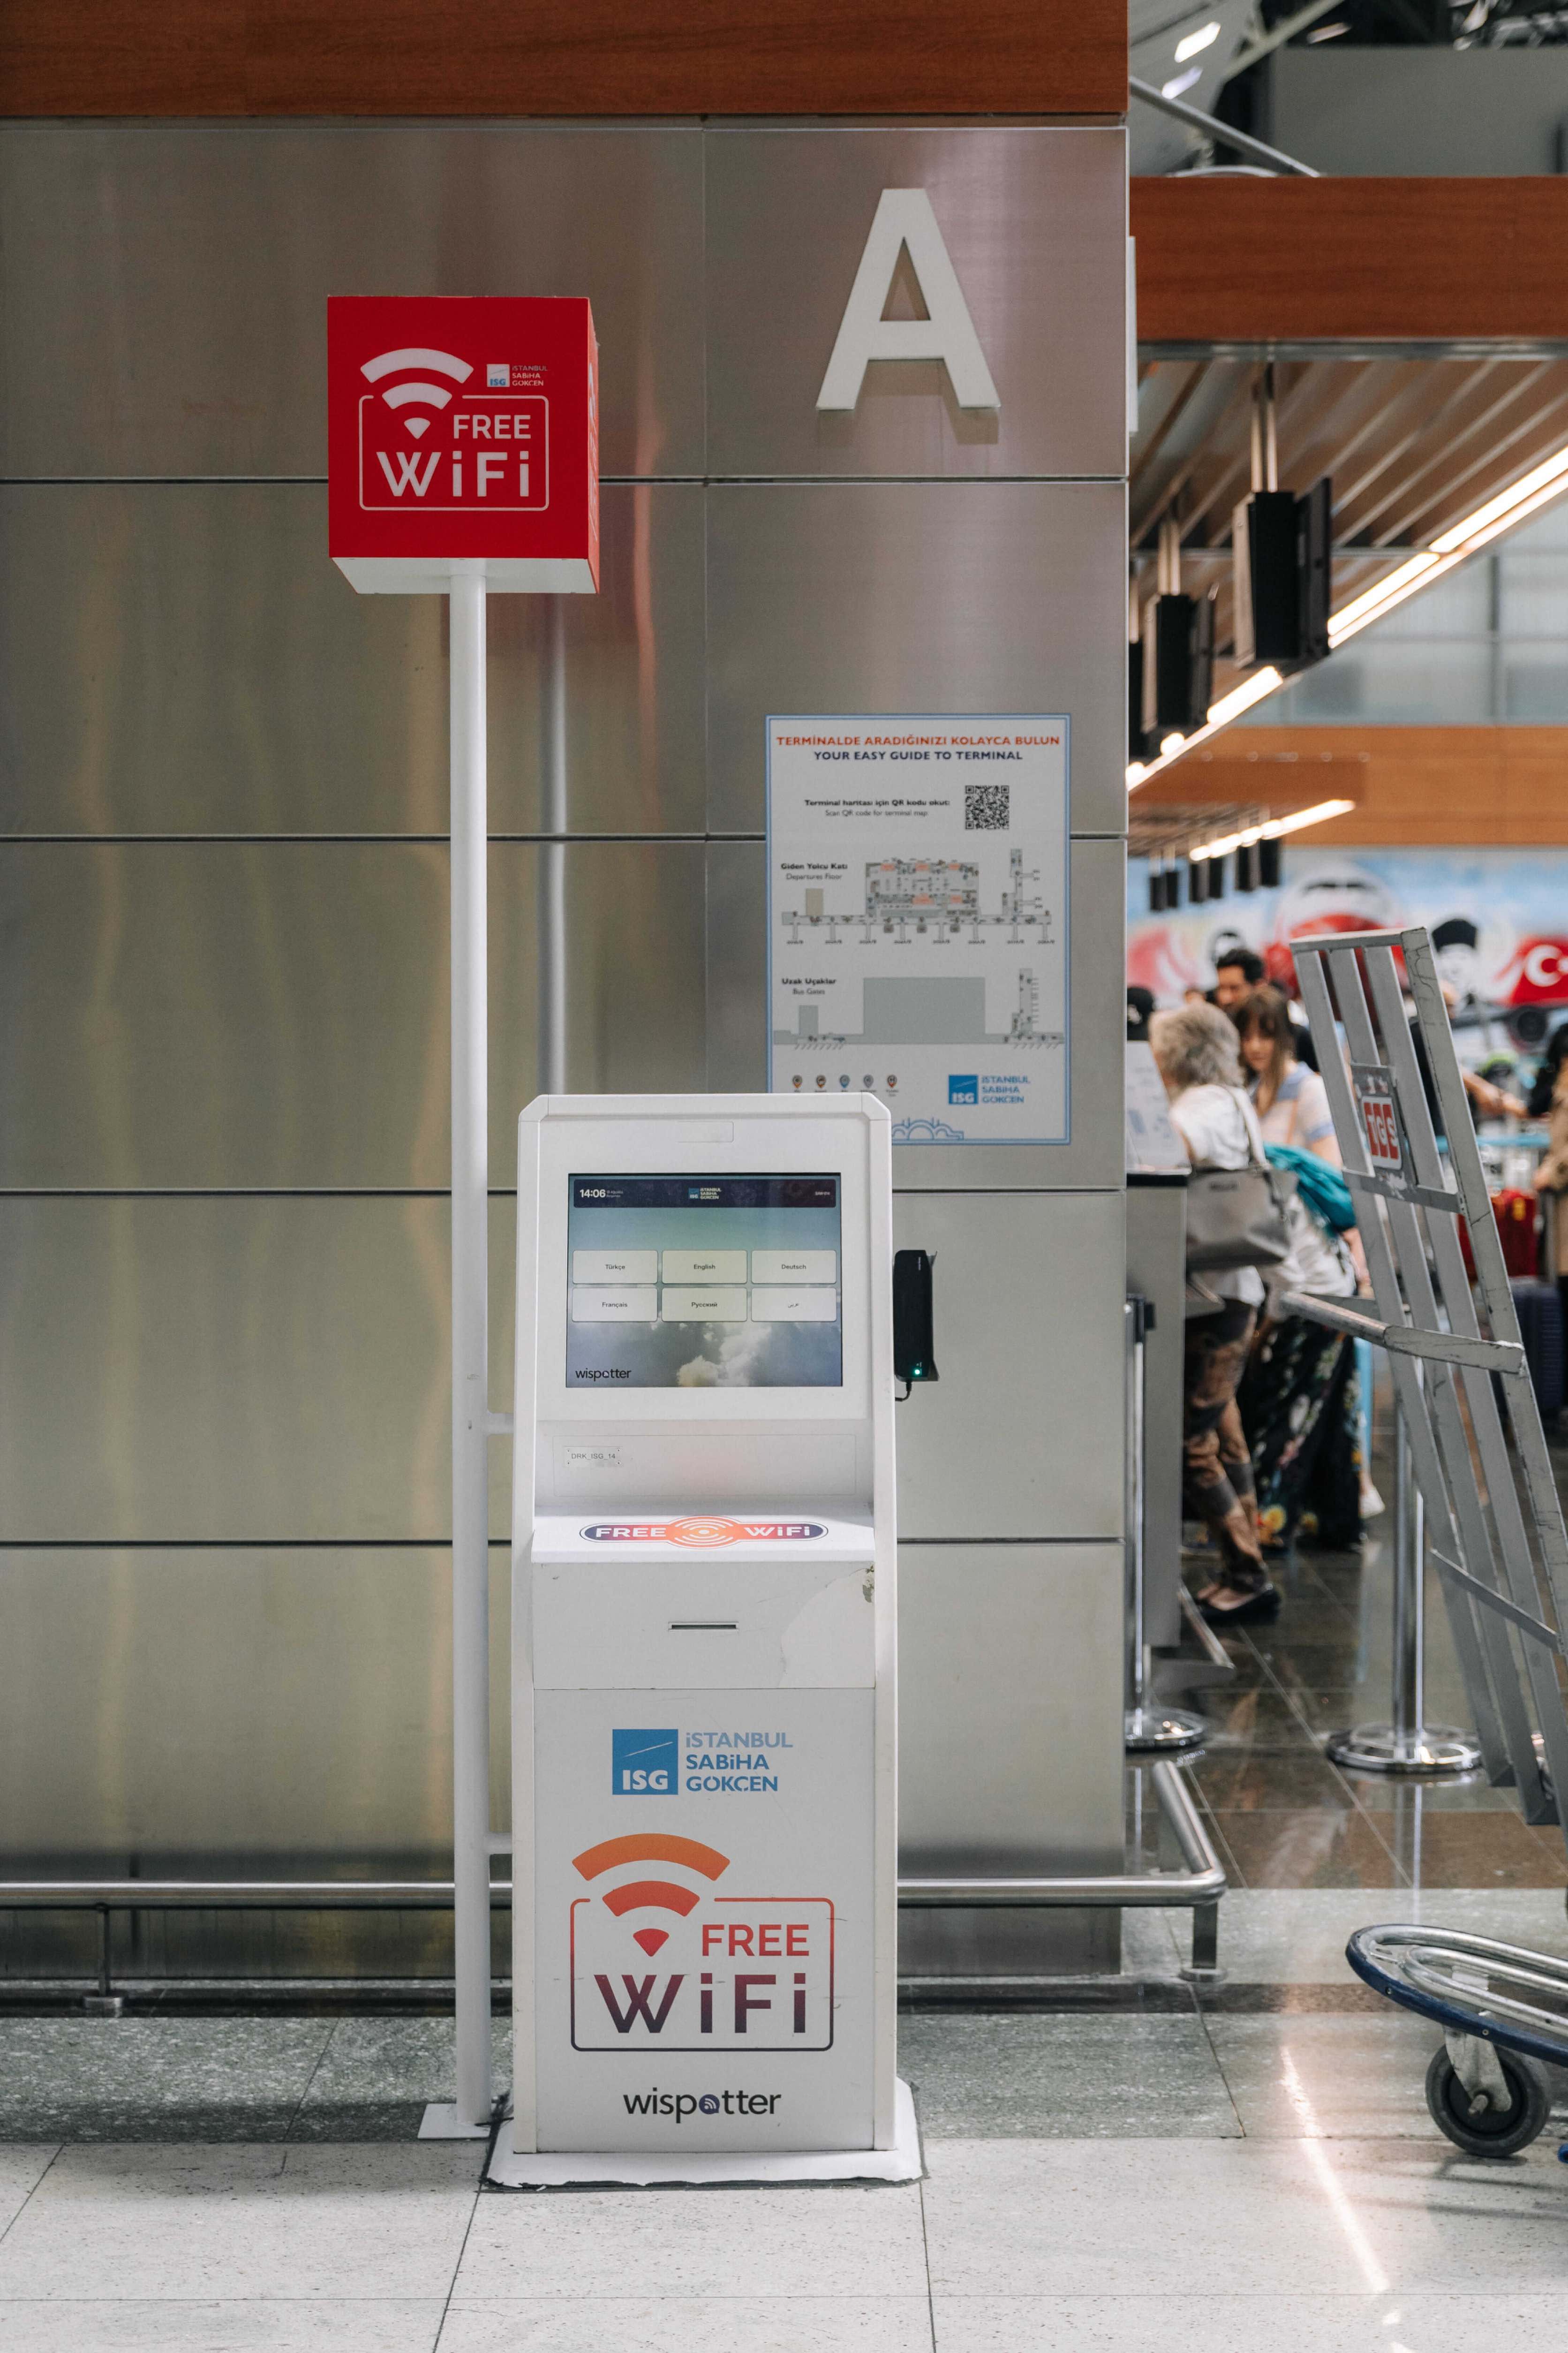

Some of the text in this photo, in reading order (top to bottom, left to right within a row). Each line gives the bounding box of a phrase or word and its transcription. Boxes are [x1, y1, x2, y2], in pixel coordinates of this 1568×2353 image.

[816, 189, 1001, 410] A
[453, 415, 531, 439] FREE
[377, 450, 529, 497] WiFi
[776, 735, 860, 745] TERMİNALDE
[951, 736, 1011, 745] KOLAYCA
[1015, 736, 1060, 745] BULUN
[814, 751, 1023, 760] YOUR EASY GUIDE TO TERMINAL
[952, 1092, 974, 1103] ISG
[1366, 1114, 1398, 1146] TGS
[580, 1189, 606, 1198] 14:06
[575, 1368, 632, 1382] wispotter
[595, 1526, 810, 1537] FREE WiFi
[622, 1770, 668, 1790] ISG
[702, 1924, 810, 1957] FREE
[594, 1973, 806, 2034] WiFi
[623, 2087, 782, 2124] wispotter
